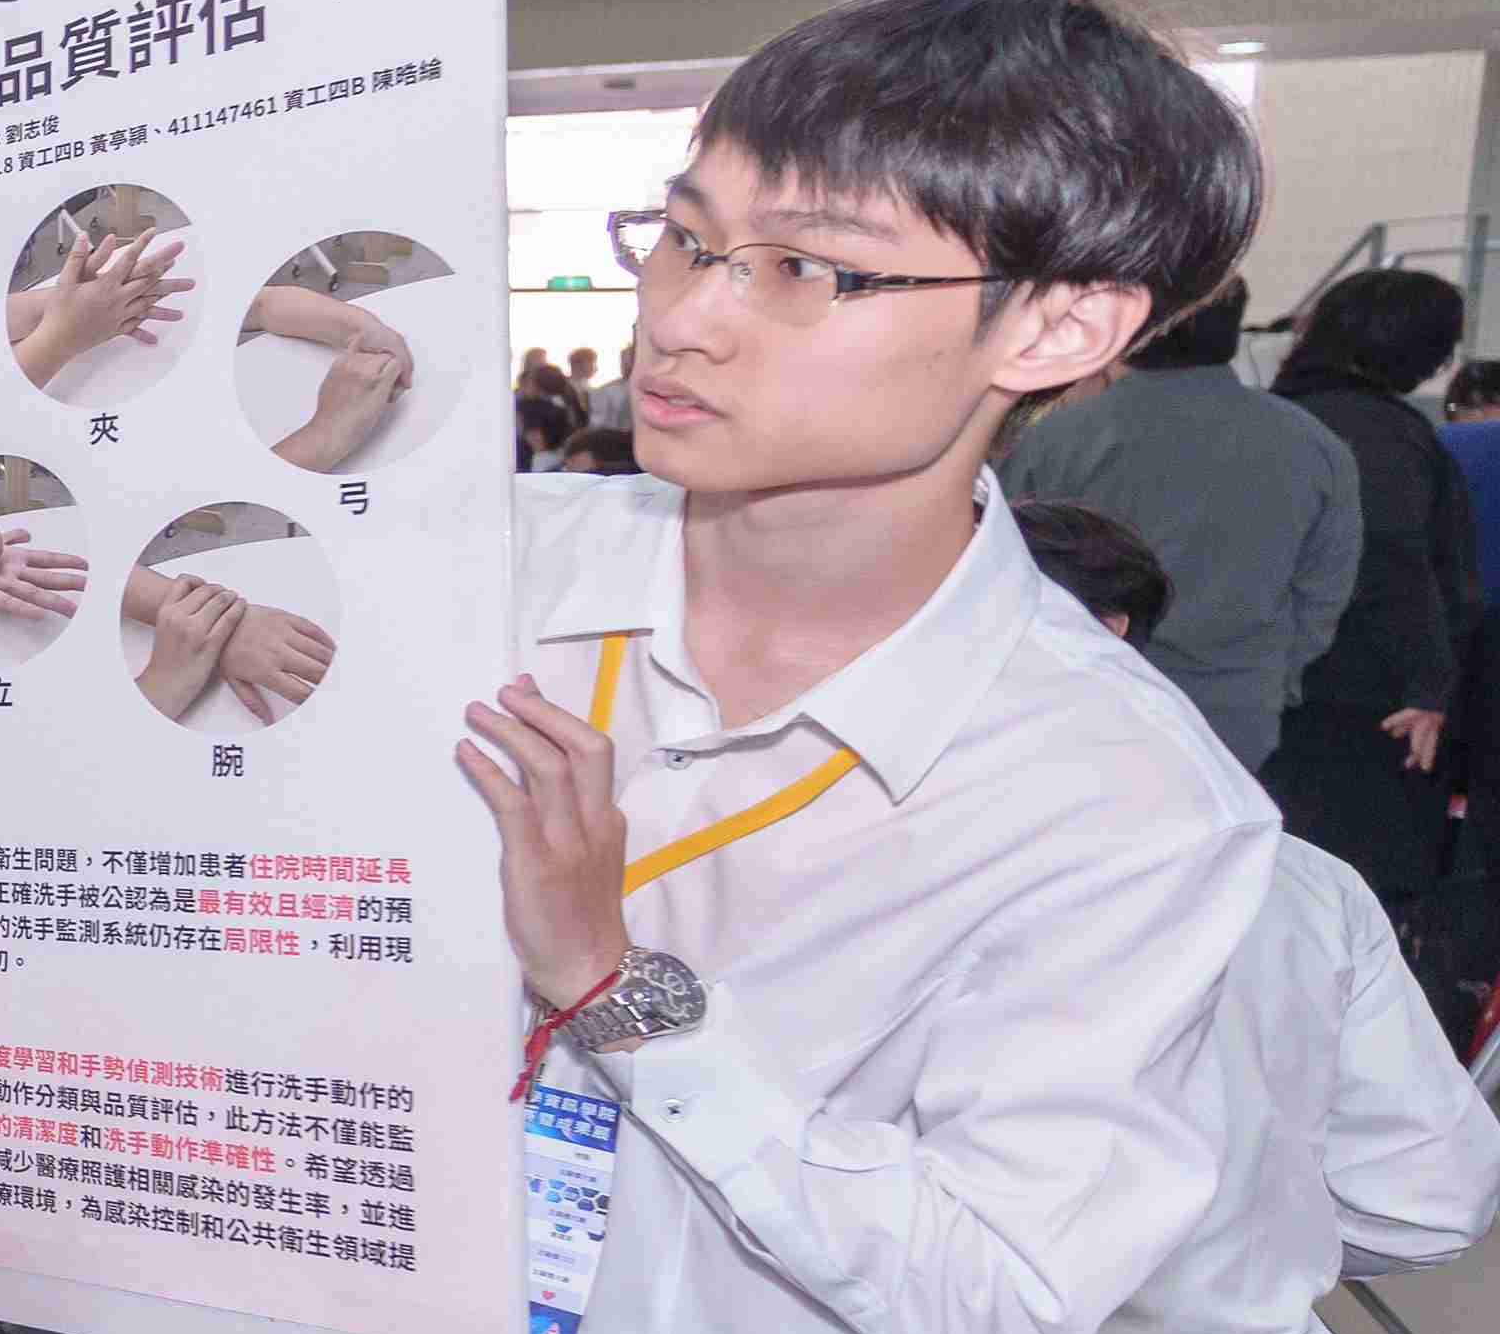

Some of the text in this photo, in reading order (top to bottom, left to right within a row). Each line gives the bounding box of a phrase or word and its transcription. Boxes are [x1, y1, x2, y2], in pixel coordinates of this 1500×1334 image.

[5, 114, 60, 147] 劉志俊
[18, 140, 85, 173] 資工四B
[283, 75, 366, 113] 資工四B
[89, 412, 121, 447] 夾
[339, 481, 370, 516] 弓
[212, 744, 246, 779] 腕
